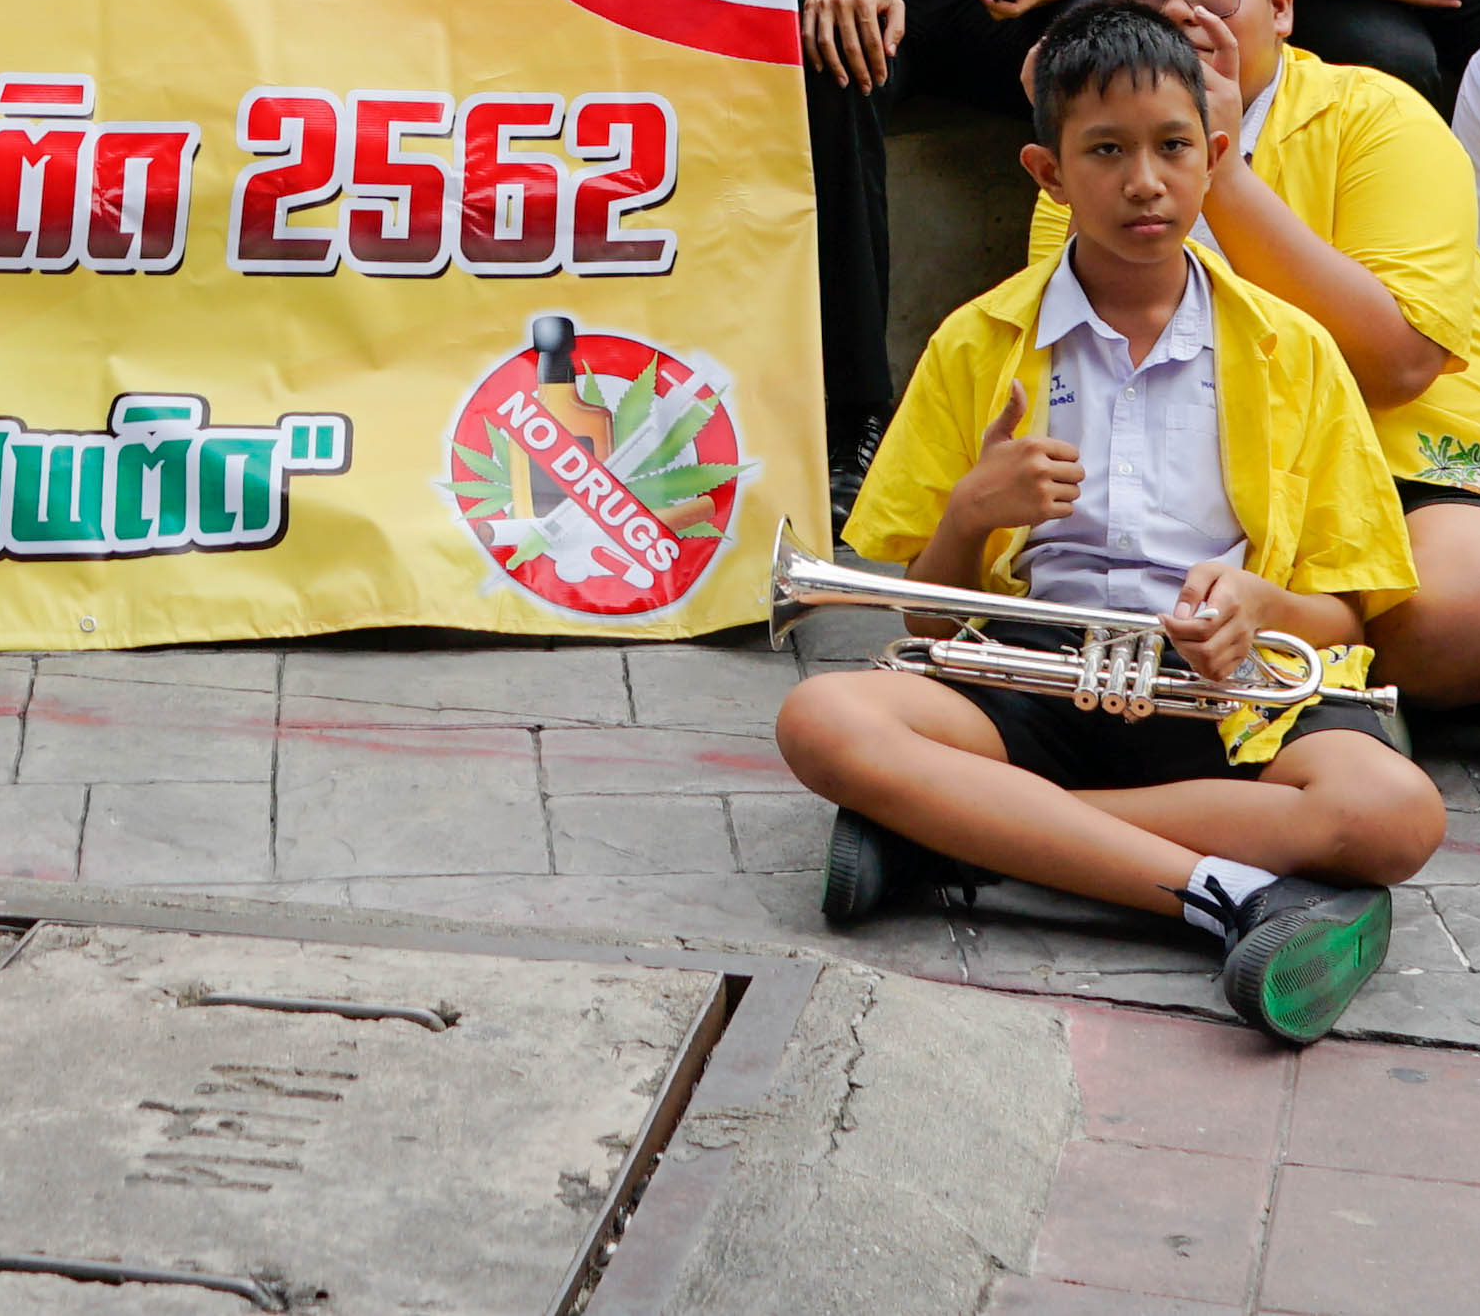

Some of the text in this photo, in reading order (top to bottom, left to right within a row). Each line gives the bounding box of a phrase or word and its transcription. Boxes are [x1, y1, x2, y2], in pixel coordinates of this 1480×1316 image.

[236, 98, 672, 265] 2562
[496, 390, 680, 572] NO DRUGS
